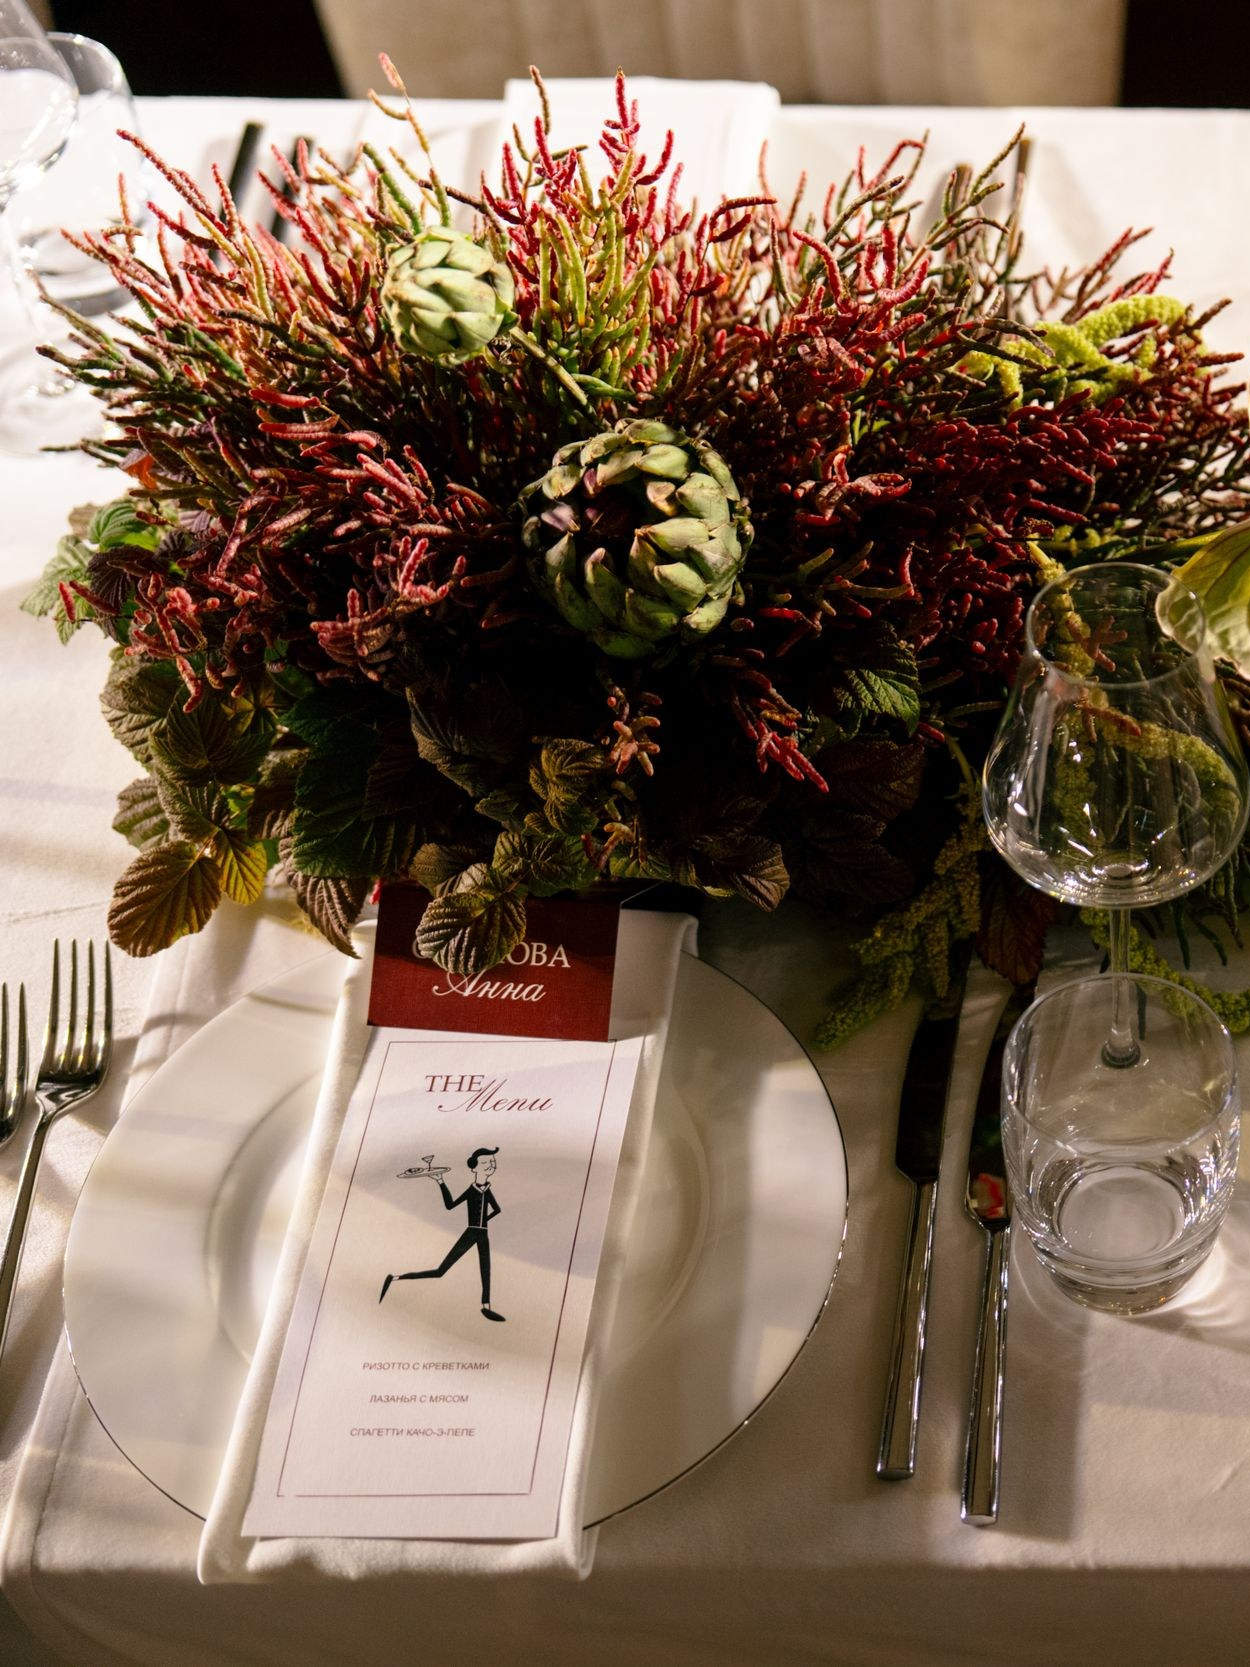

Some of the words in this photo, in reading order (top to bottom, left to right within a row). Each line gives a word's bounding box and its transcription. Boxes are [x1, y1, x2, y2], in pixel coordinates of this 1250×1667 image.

[432, 969, 547, 1002] Анна
[425, 1075, 485, 1093] THE
[437, 1078, 553, 1112] Menu
[362, 1362, 411, 1371] РИЗОТТО
[412, 1362, 420, 1371] С
[422, 1362, 490, 1371] КРЕВЕТКАМИ
[369, 1394, 417, 1404] ЛАЗАНЬЯ
[419, 1394, 427, 1403] С
[429, 1394, 469, 1404] МЯСОМ
[350, 1428, 404, 1437] СПАГЕТТИ
[406, 1428, 476, 1437] КАЧО-Э-ПЕПЕ
